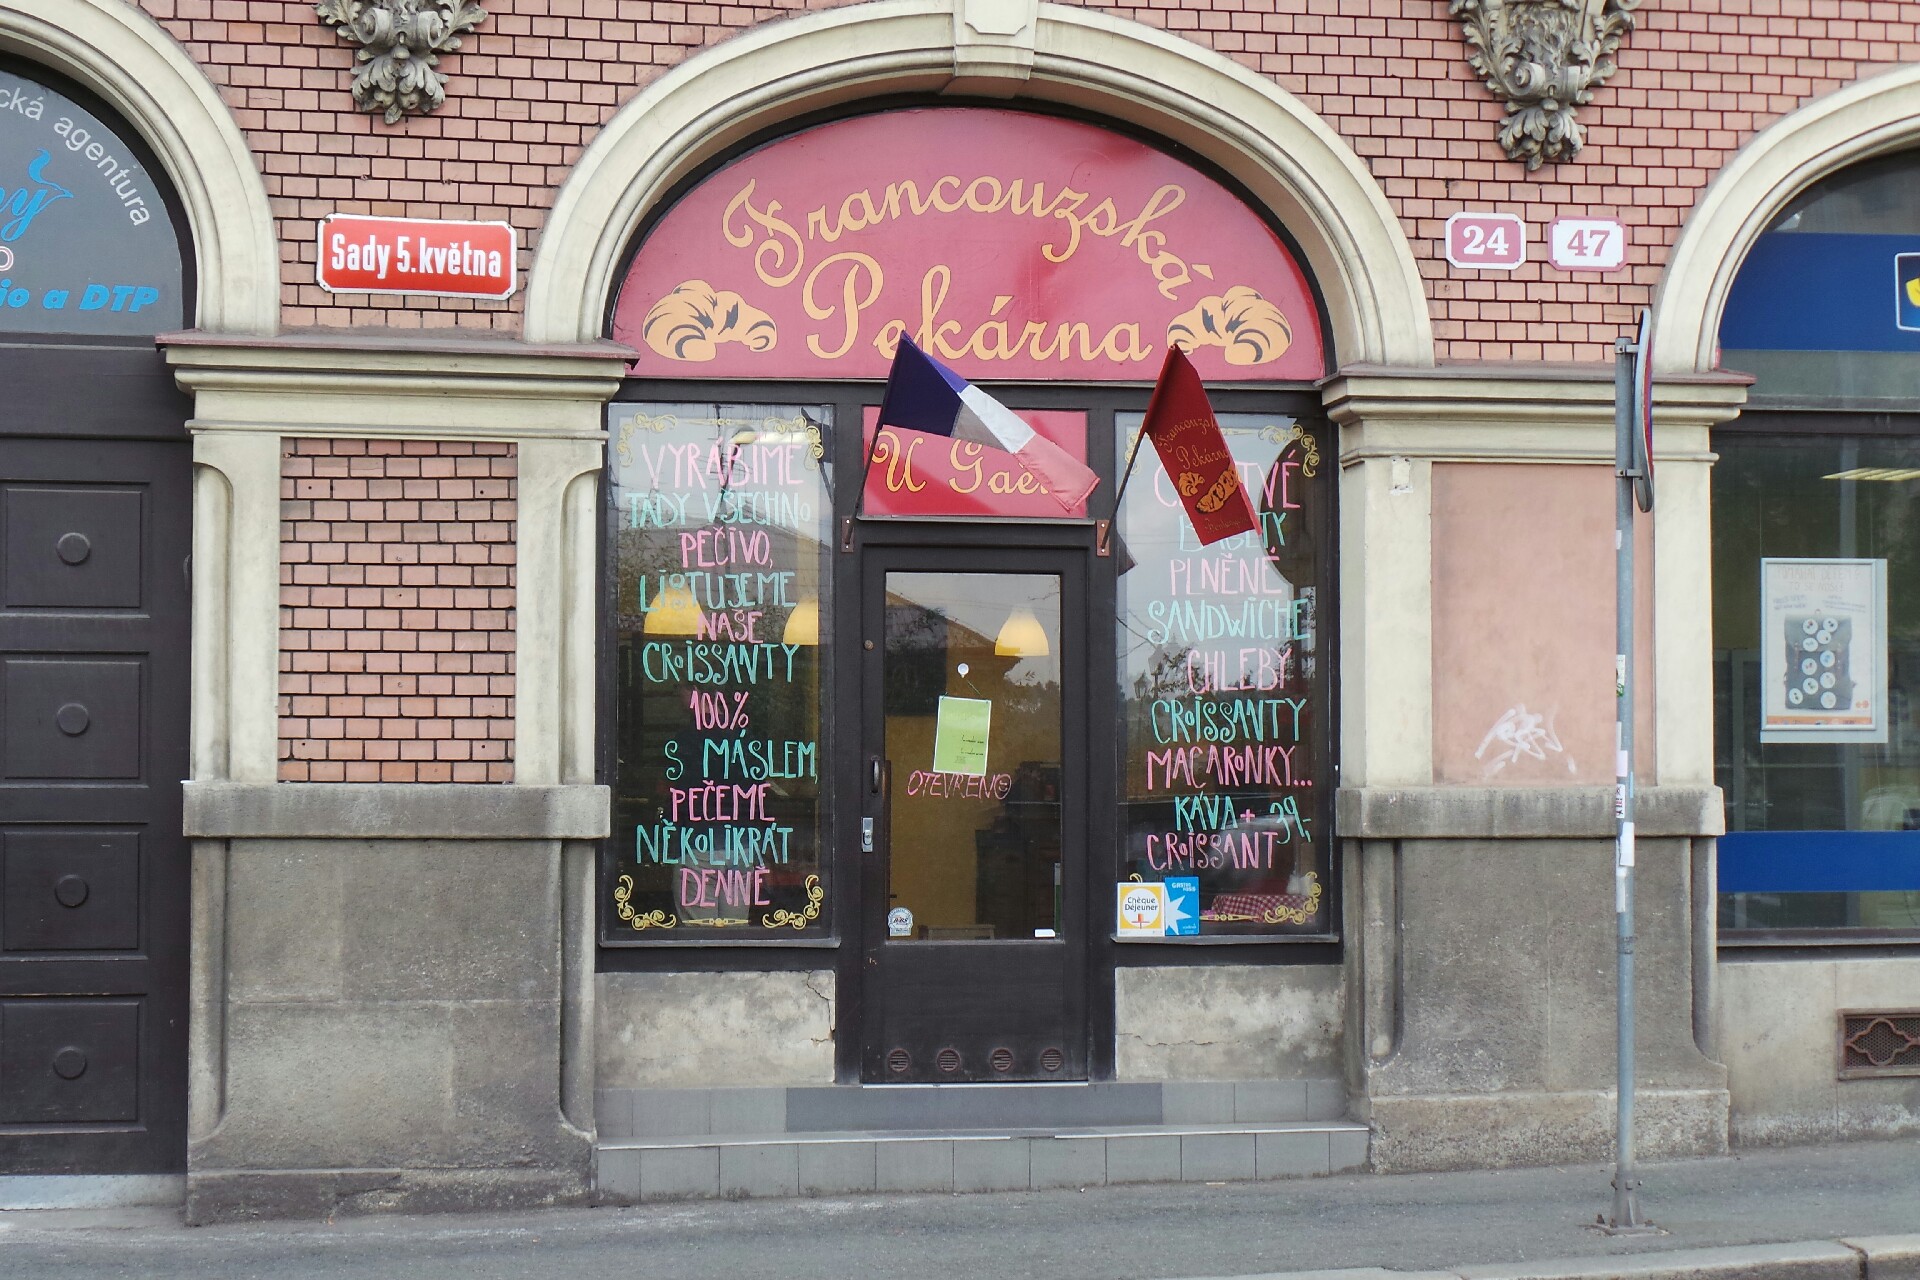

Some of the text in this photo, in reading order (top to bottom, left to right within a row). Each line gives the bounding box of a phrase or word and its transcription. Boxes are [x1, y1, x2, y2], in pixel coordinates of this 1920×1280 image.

[53, 117, 150, 226] agentura
[331, 233, 390, 280] Sady
[722, 175, 1214, 301] Francouzská
[1462, 225, 1510, 256] 24
[1567, 229, 1611, 257] 47
[42, 289, 70, 311] a
[79, 284, 159, 313] DTP
[802, 251, 1153, 362] Pekárna
[624, 492, 690, 528] TADY
[1170, 546, 1282, 596] PLNĚNÉ
[1187, 647, 1293, 693] CHLEBY
[689, 690, 749, 730] 100%
[664, 740, 684, 780] S
[670, 779, 775, 822] PEČEME
[1174, 790, 1239, 832] KÁVA
[680, 866, 770, 907] DENNĚ
[1124, 903, 1158, 912] Déjeuner
